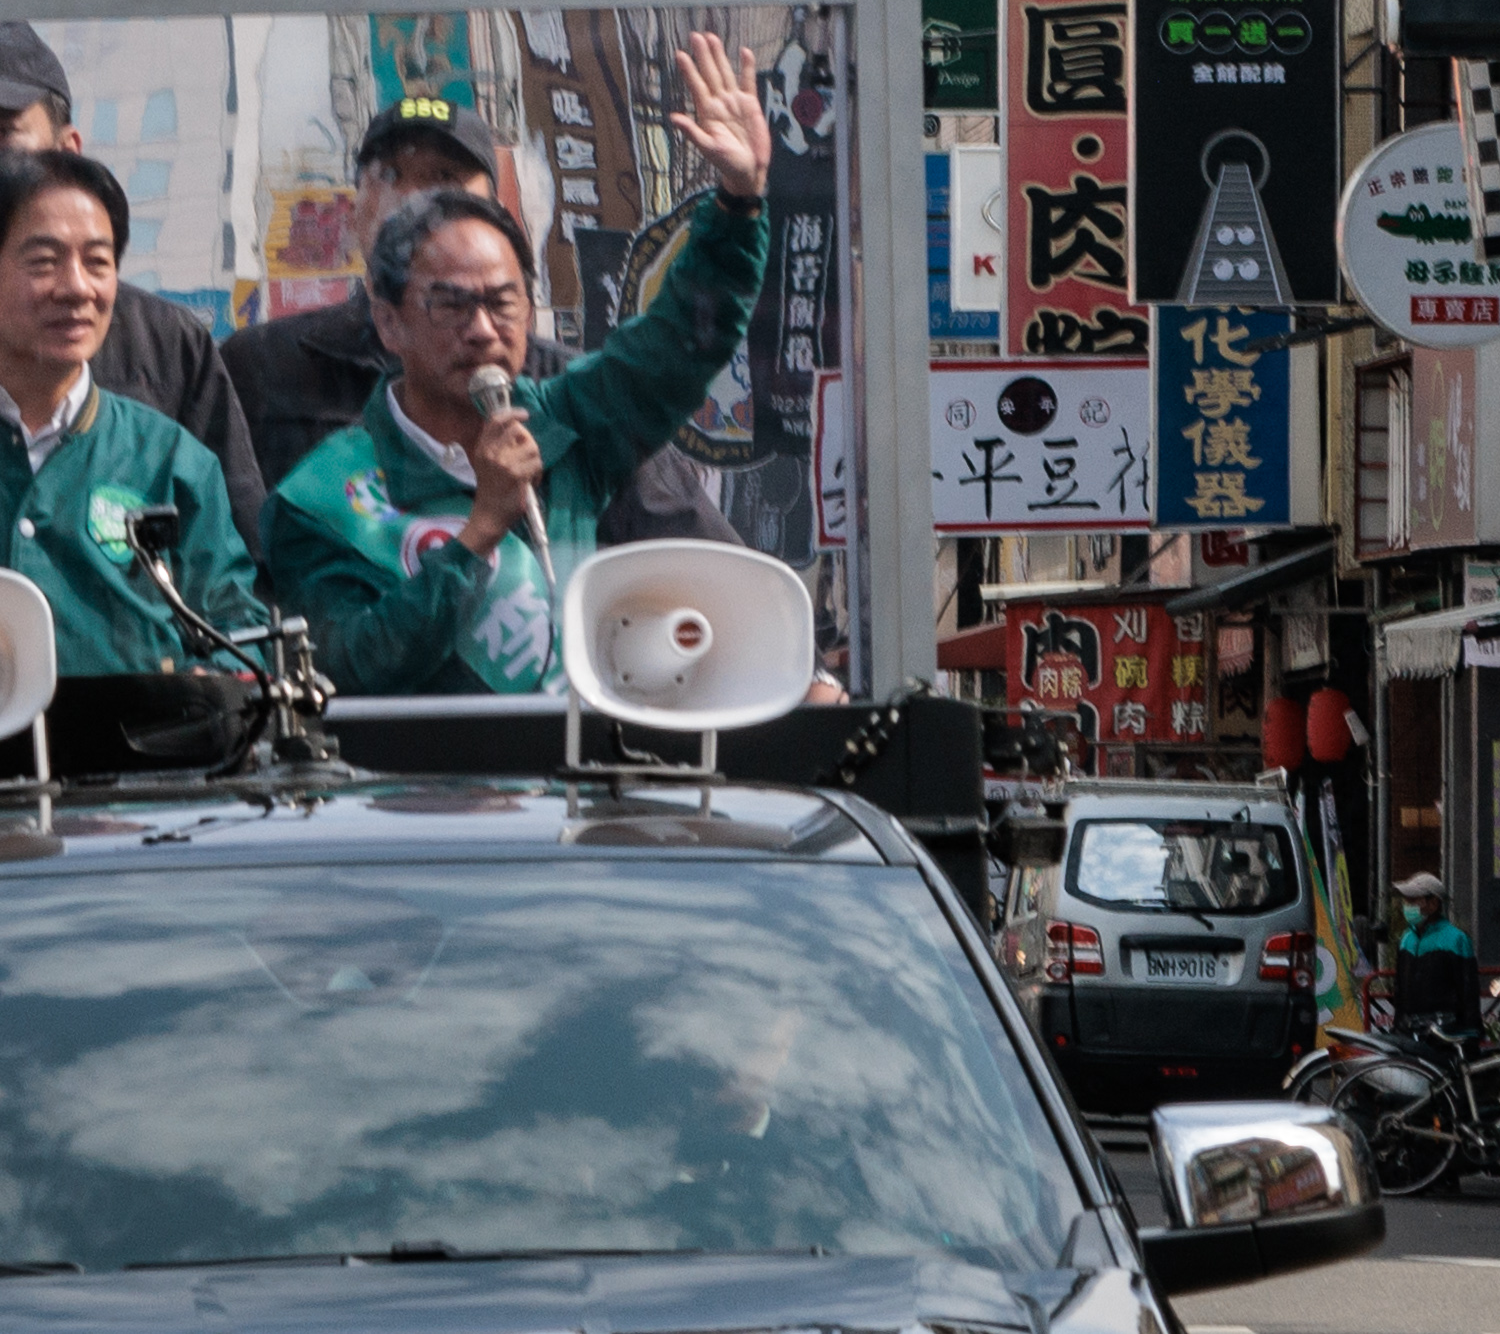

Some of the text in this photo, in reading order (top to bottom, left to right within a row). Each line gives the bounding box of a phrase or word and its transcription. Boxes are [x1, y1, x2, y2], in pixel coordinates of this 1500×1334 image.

[1166, 17, 1306, 46] 買一送一
[1415, 299, 1495, 322] 專賣店
[1181, 304, 1265, 518] 化學儀器
